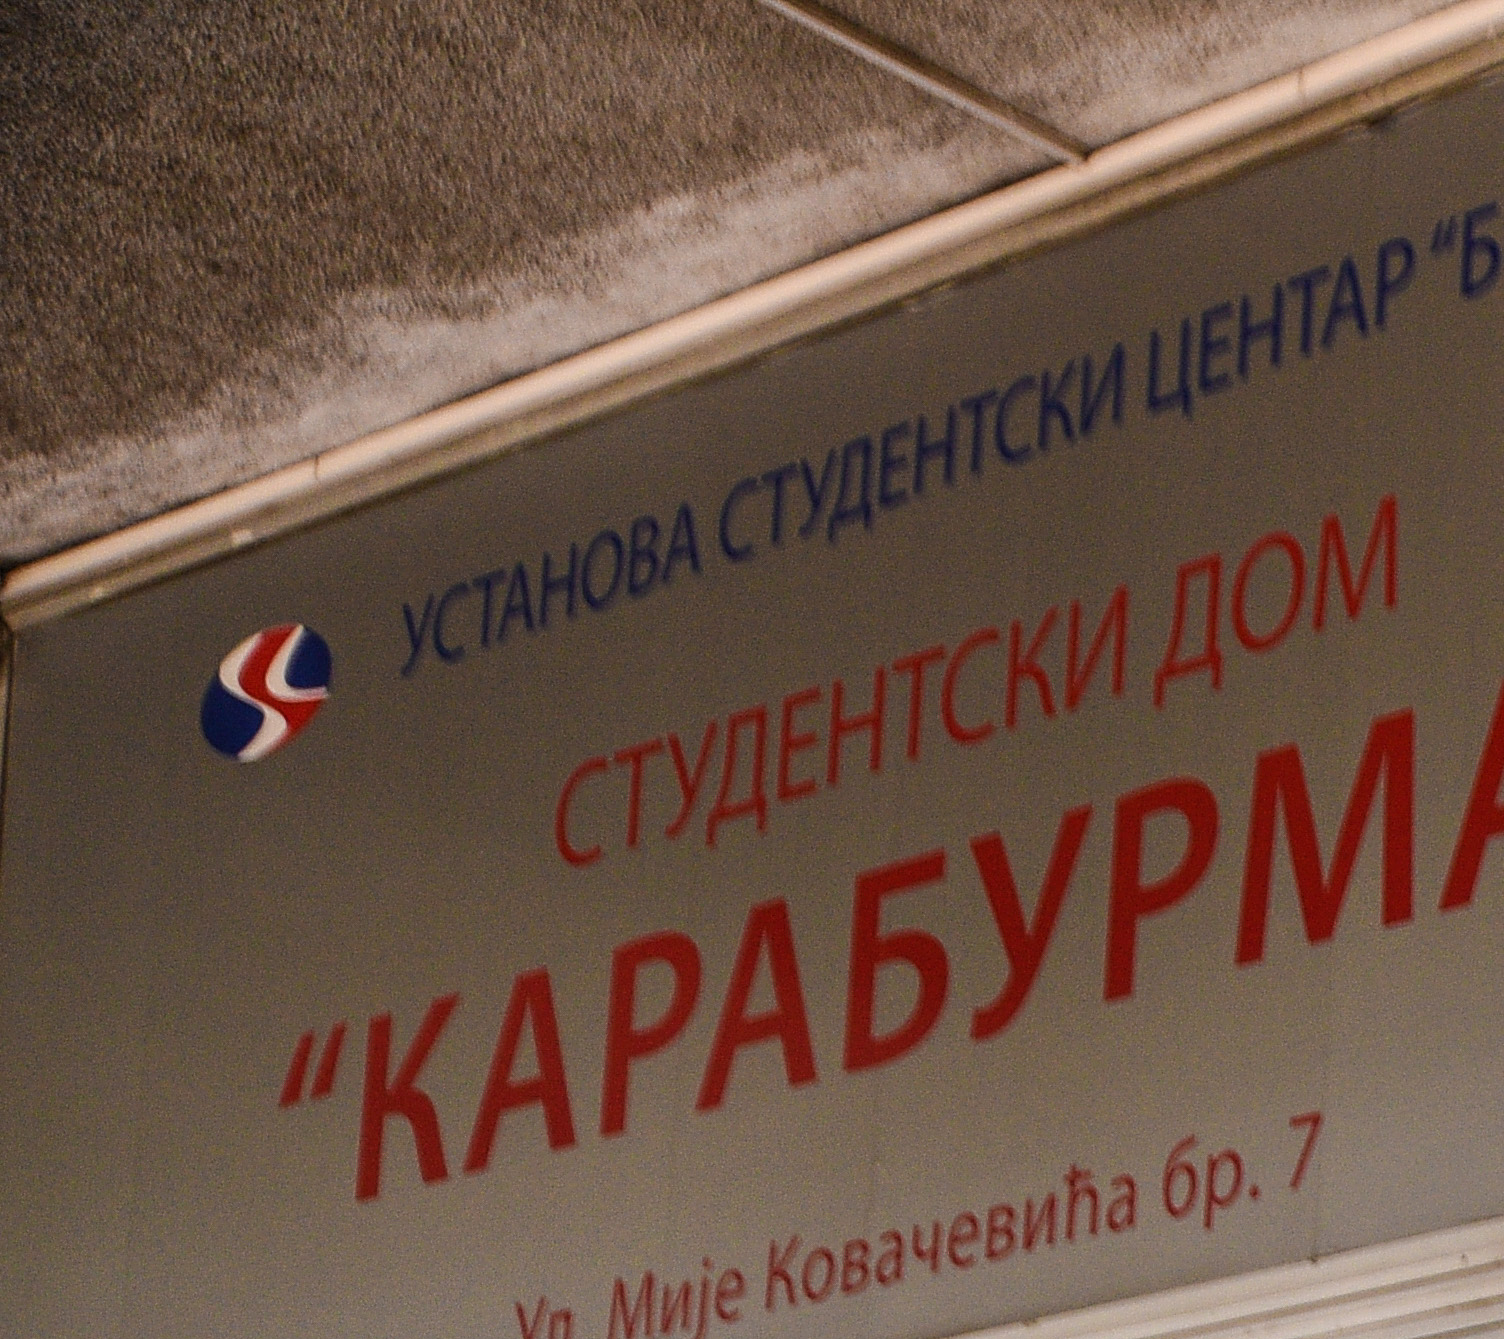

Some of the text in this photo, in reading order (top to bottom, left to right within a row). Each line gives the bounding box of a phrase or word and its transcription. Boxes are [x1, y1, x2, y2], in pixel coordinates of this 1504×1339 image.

[402, 503, 701, 677] УСТАНОВА
[719, 342, 1127, 564] СТУДЕНТСКИ
[1146, 237, 1415, 417] ЦЕНТАР
[555, 493, 1398, 868] СТУДЕНТСКИ ДОМ
[765, 1162, 1138, 1311] Ковачевића
[1162, 1135, 1260, 1229] бр.
[1289, 1111, 1322, 1190] 7
